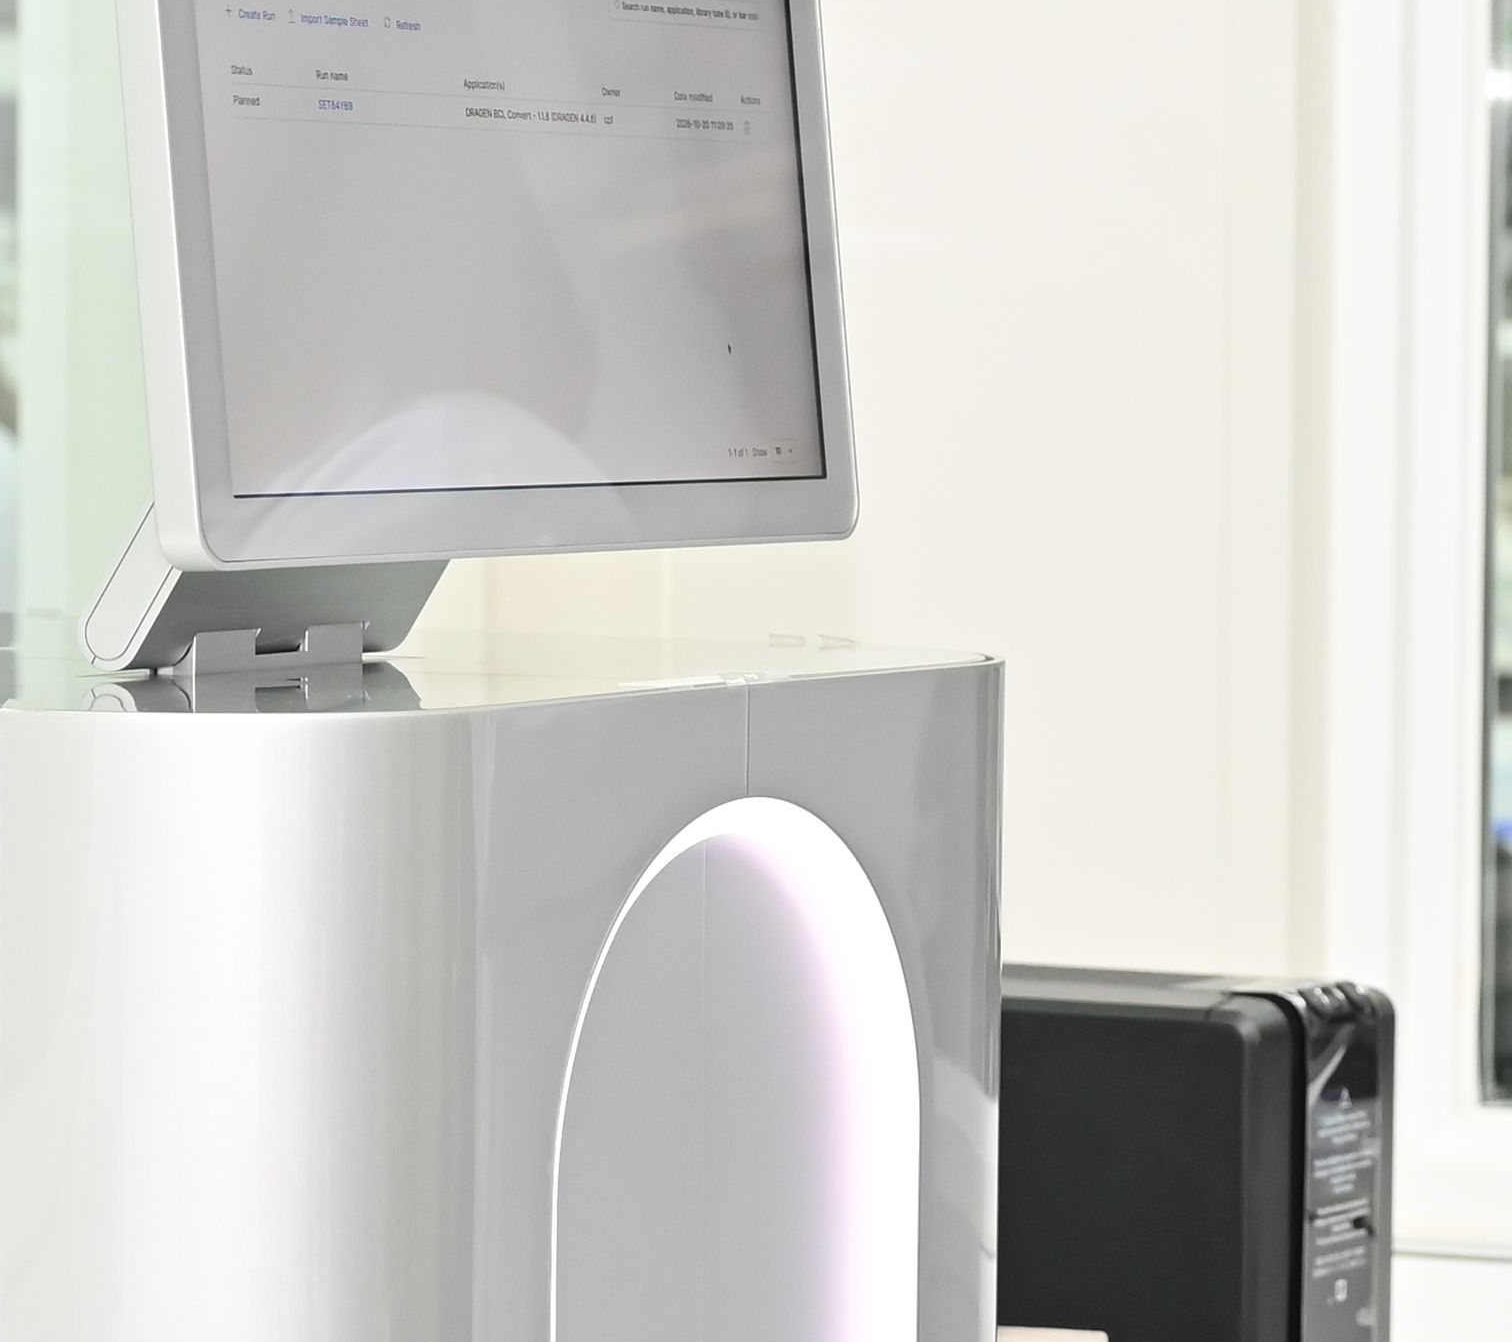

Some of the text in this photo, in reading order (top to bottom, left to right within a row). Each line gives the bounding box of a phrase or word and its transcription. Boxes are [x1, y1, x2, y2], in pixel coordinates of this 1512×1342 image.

[238, 8, 276, 21] Create Run
[300, 14, 322, 25] Import
[324, 15, 348, 27] Sample
[396, 20, 421, 31] Refresh
[230, 64, 253, 76] Status
[315, 69, 348, 81] Run name
[232, 94, 260, 106] Planned
